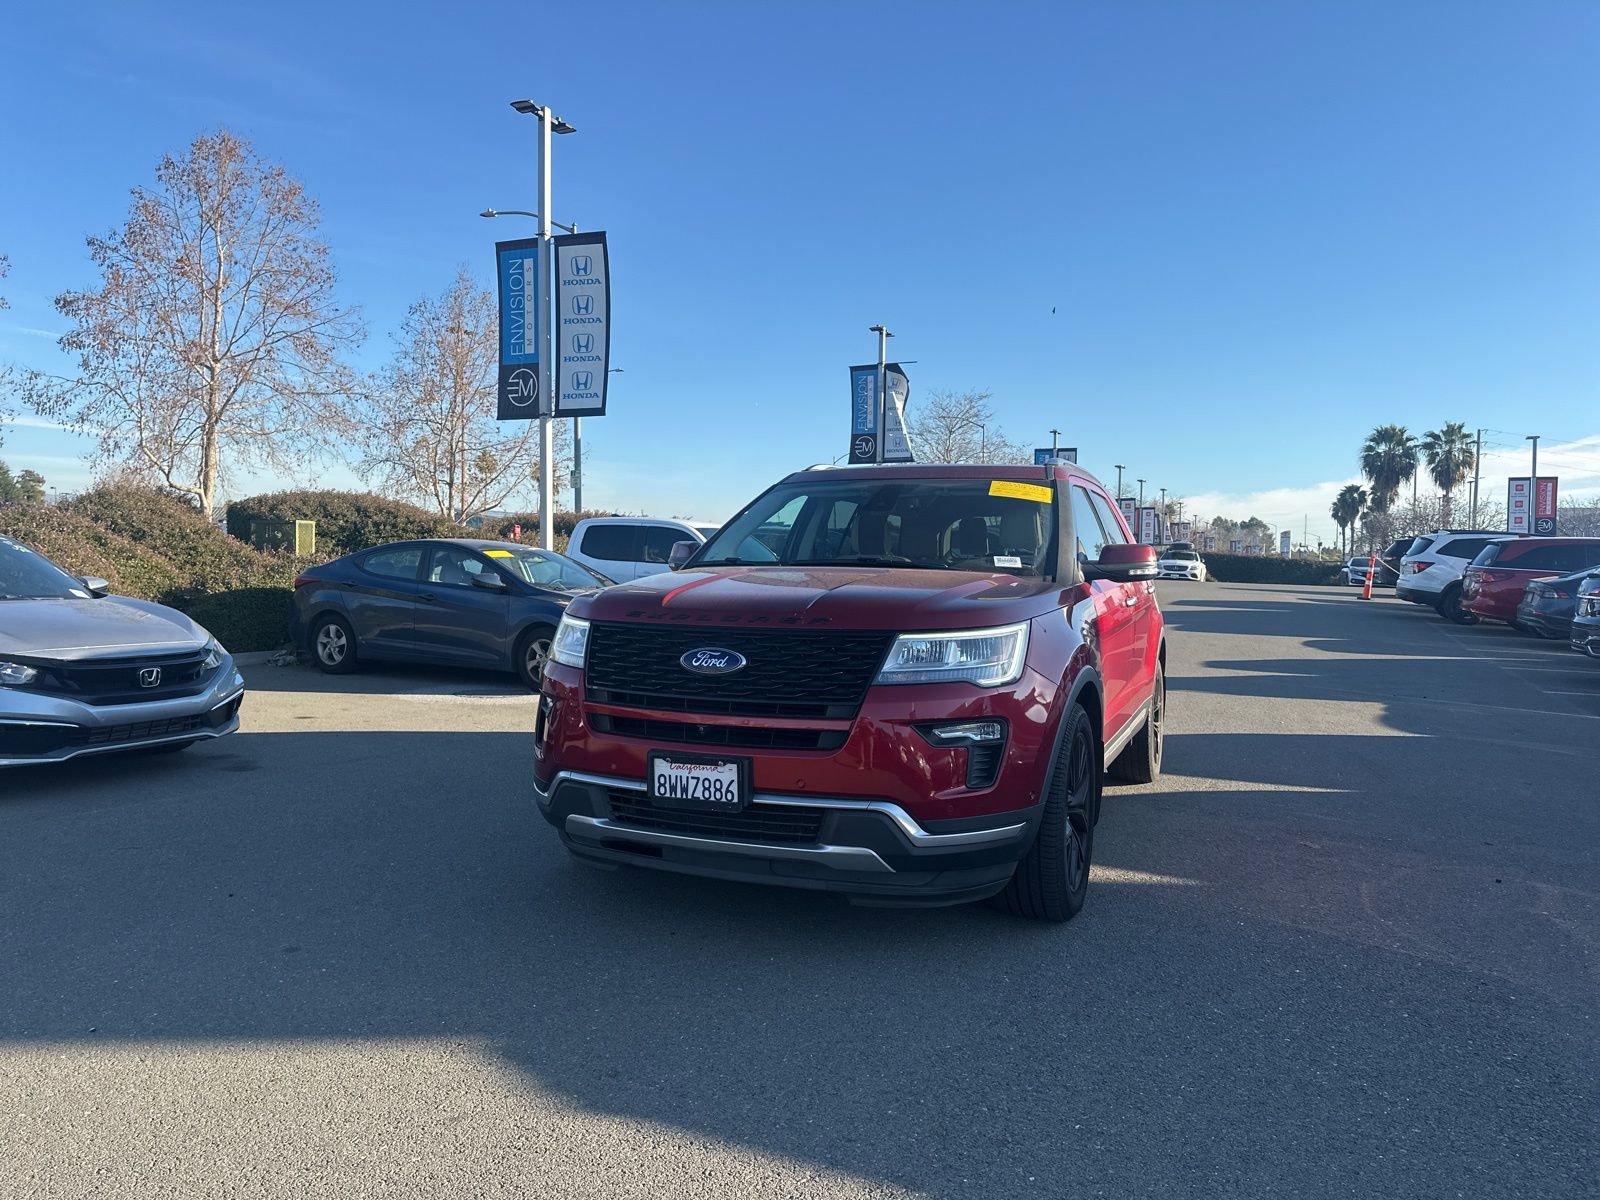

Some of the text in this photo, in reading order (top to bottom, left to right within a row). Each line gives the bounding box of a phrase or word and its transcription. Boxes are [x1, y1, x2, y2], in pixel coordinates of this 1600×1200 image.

[562, 278, 602, 286] HONDA
[510, 258, 524, 356] ENVISION
[563, 317, 603, 325] HONDA
[562, 392, 599, 400] HONDA
[857, 375, 867, 429] ENVISION
[692, 650, 729, 667] Ford
[669, 762, 720, 774] California
[657, 773, 735, 802] 8WWZ886
